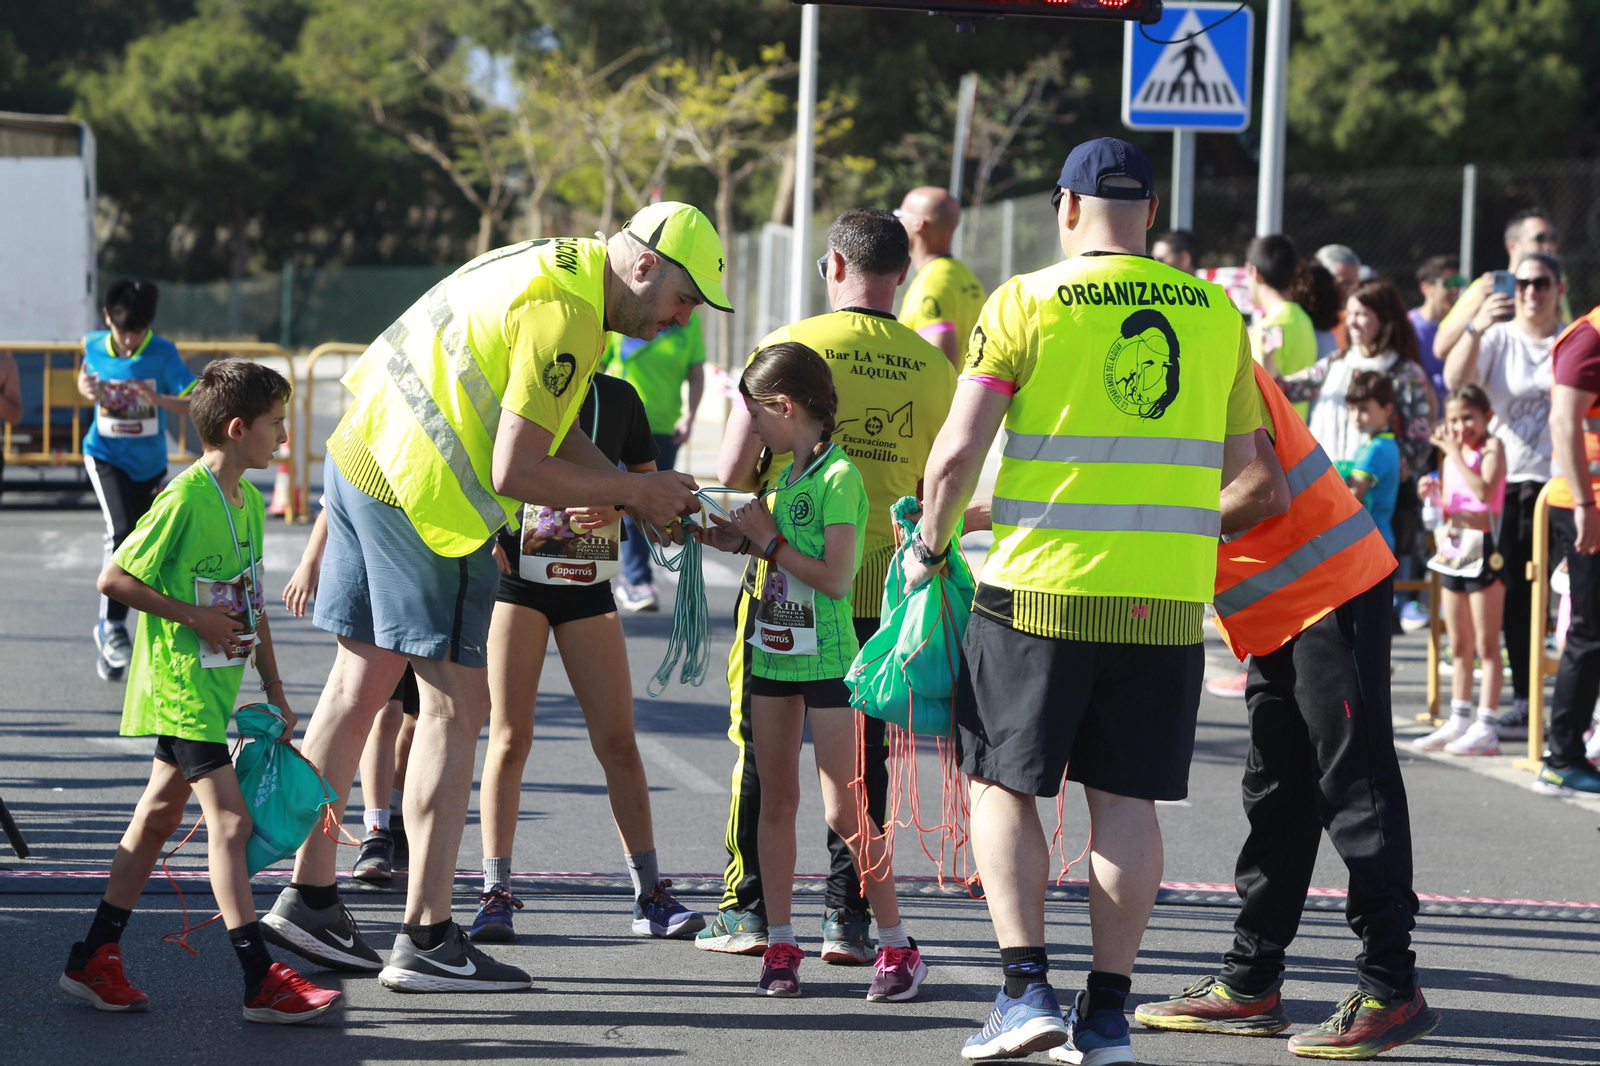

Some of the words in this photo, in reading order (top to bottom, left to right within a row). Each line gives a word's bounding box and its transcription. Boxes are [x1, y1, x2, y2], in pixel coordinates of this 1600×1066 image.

[1057, 281, 1210, 308] ORGANIZACIÓN
[825, 349, 850, 360] Bar
[854, 350, 873, 363] LA
[850, 365, 907, 381] ALQUIAN
[1105, 362, 1115, 372] DEL
[1105, 372, 1123, 404] ESPARTANOS
[842, 434, 897, 449] Excavaciones
[576, 537, 610, 546] XIII
[552, 565, 593, 576] Caparrós
[774, 601, 804, 611] XIII
